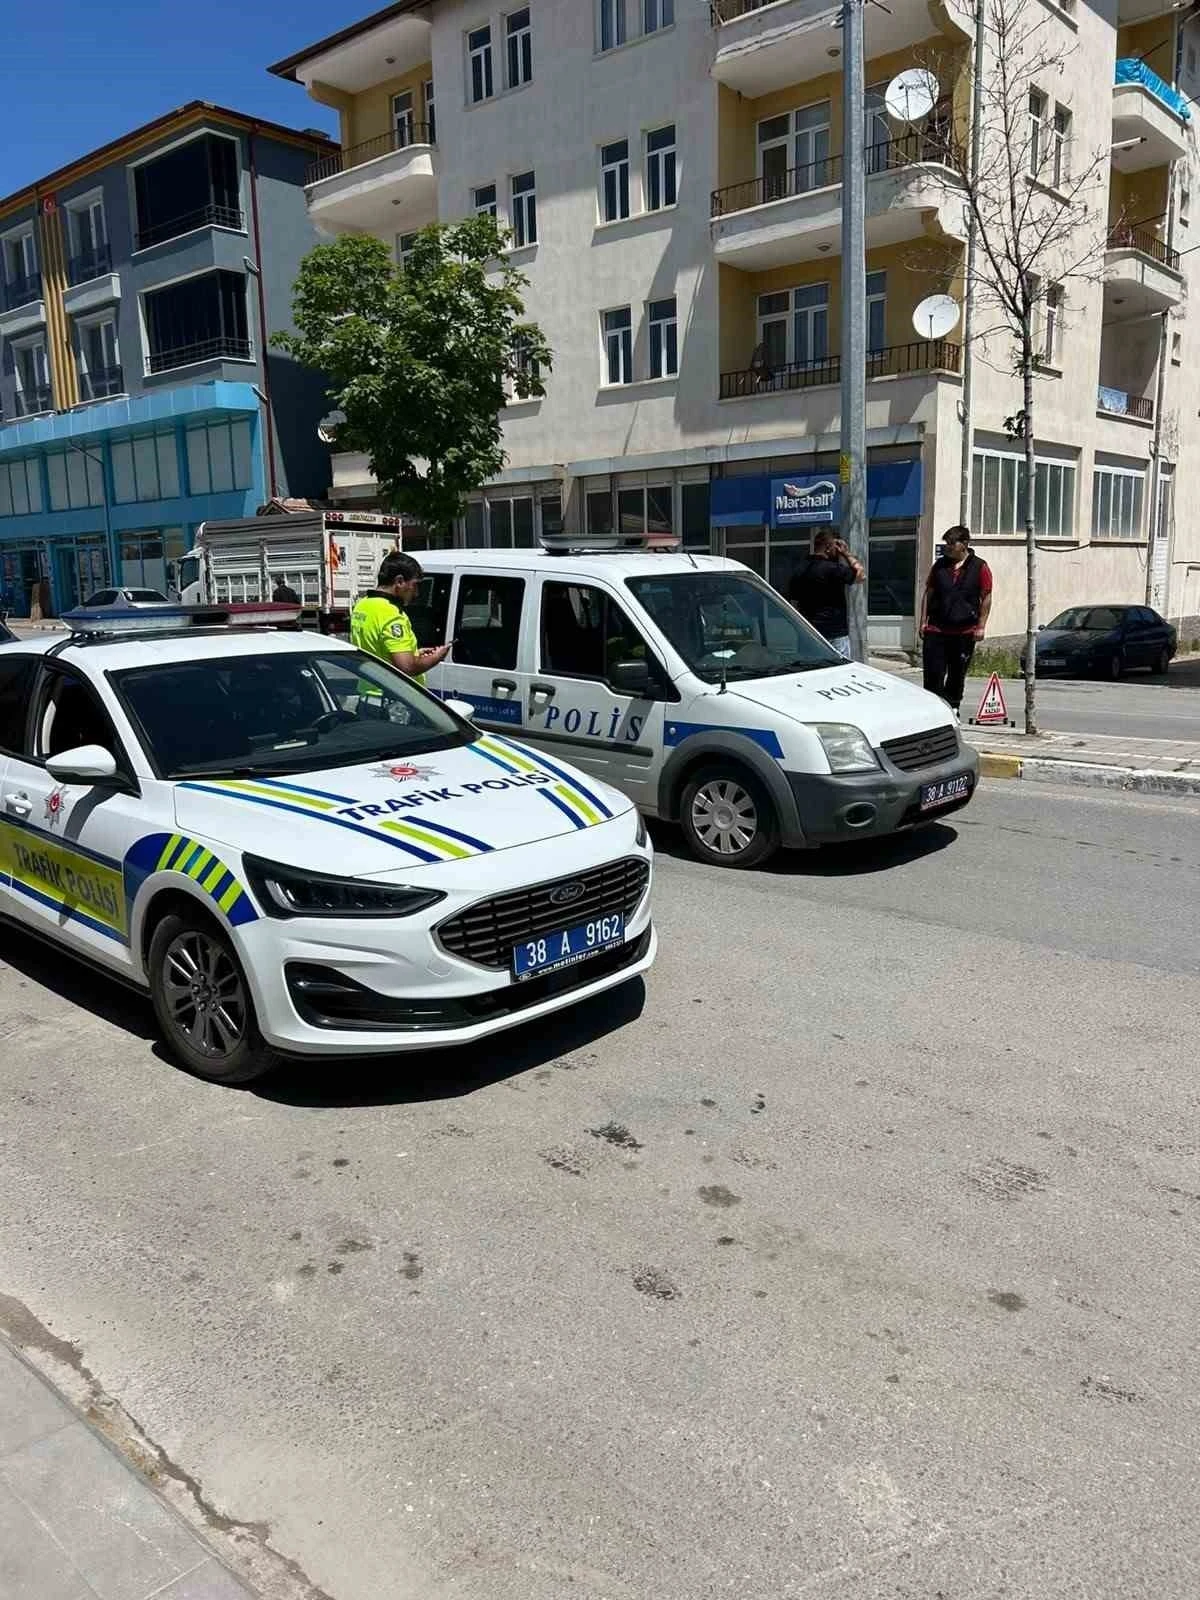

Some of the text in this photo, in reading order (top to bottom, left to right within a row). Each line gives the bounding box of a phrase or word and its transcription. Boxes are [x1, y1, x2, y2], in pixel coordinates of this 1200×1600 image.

[776, 494, 829, 510] Marshall
[544, 706, 645, 743] POLİS
[337, 769, 560, 821] TRAFİK POLİSİ
[926, 786, 937, 802] 38
[938, 783, 944, 798] A
[13, 842, 120, 919] TRAFİK POLİSİ
[526, 914, 620, 967] 38 A 9162
